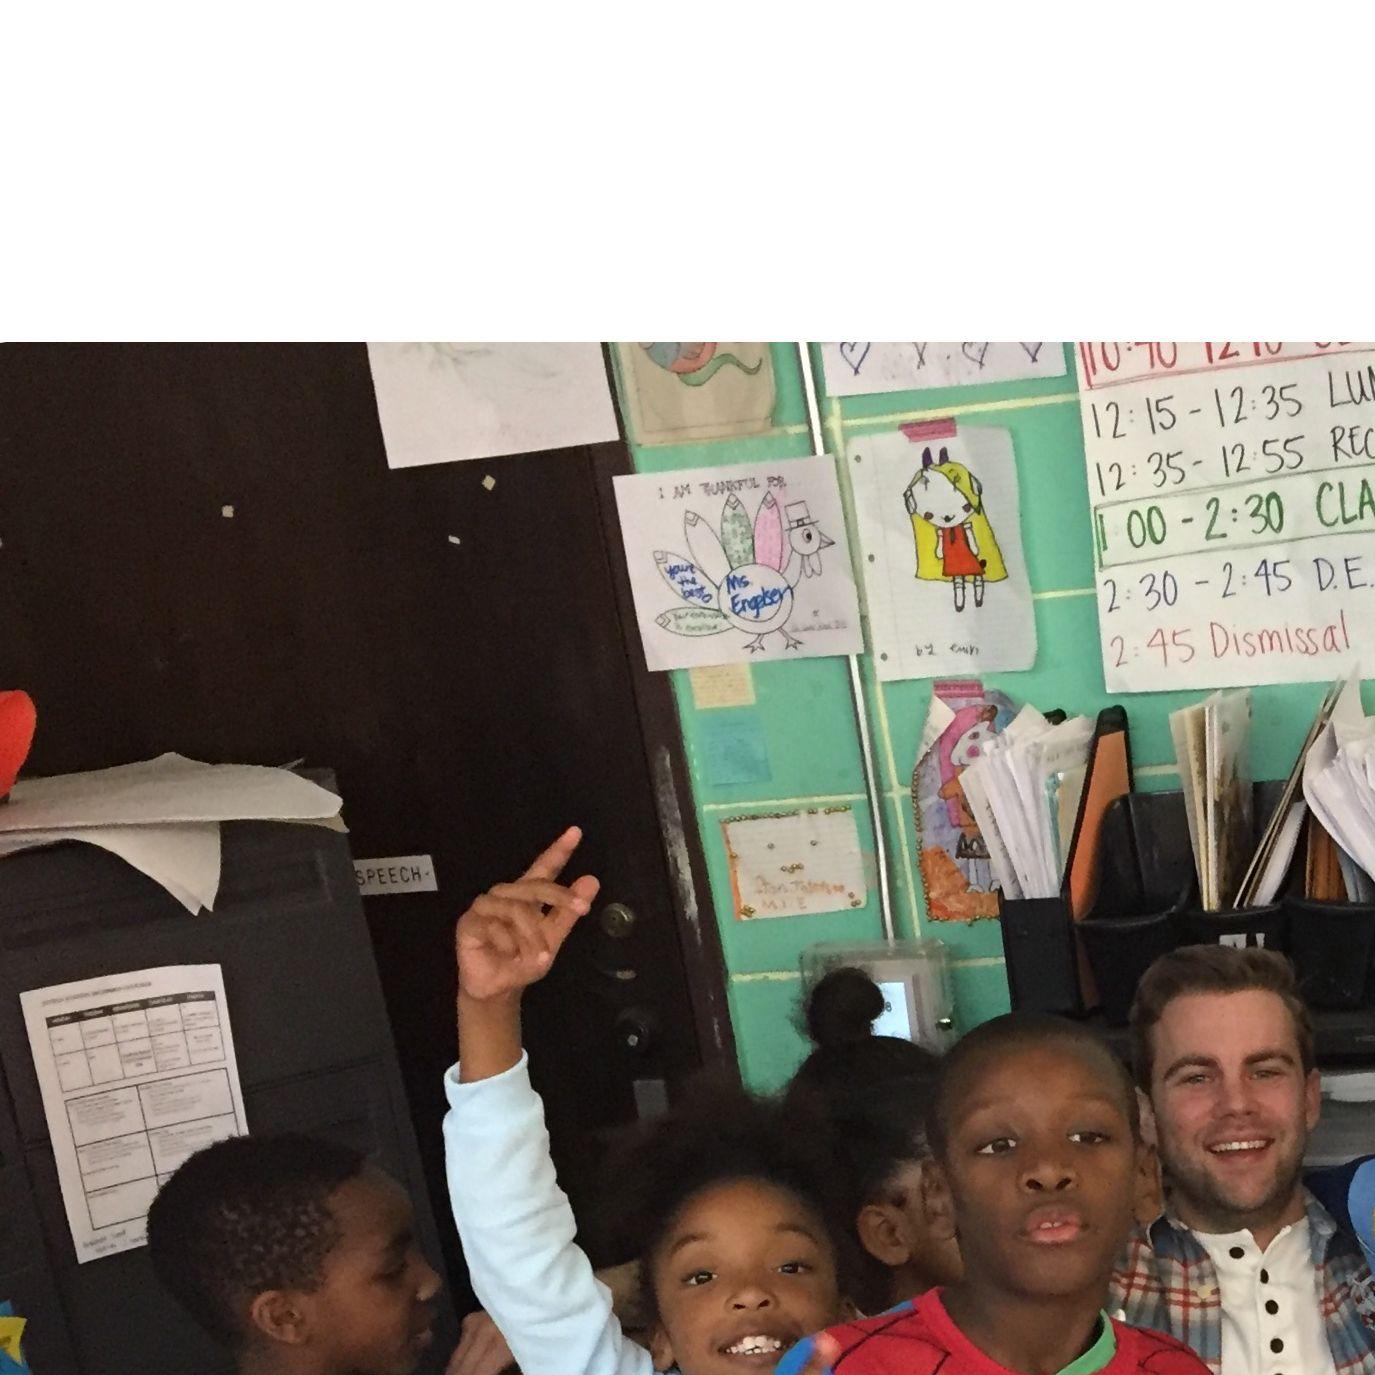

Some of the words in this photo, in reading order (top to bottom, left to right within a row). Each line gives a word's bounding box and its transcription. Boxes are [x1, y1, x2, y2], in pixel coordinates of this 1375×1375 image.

[1214, 383, 1303, 428] 12:35
[1222, 434, 1306, 478] 12:55
[673, 483, 691, 499] AM
[1204, 491, 1285, 543] 2:30
[1102, 569, 1179, 614] 2:30
[1221, 557, 1293, 600] 2:45
[1109, 628, 1196, 669] 2:45
[1209, 609, 1351, 659] Dismissal
